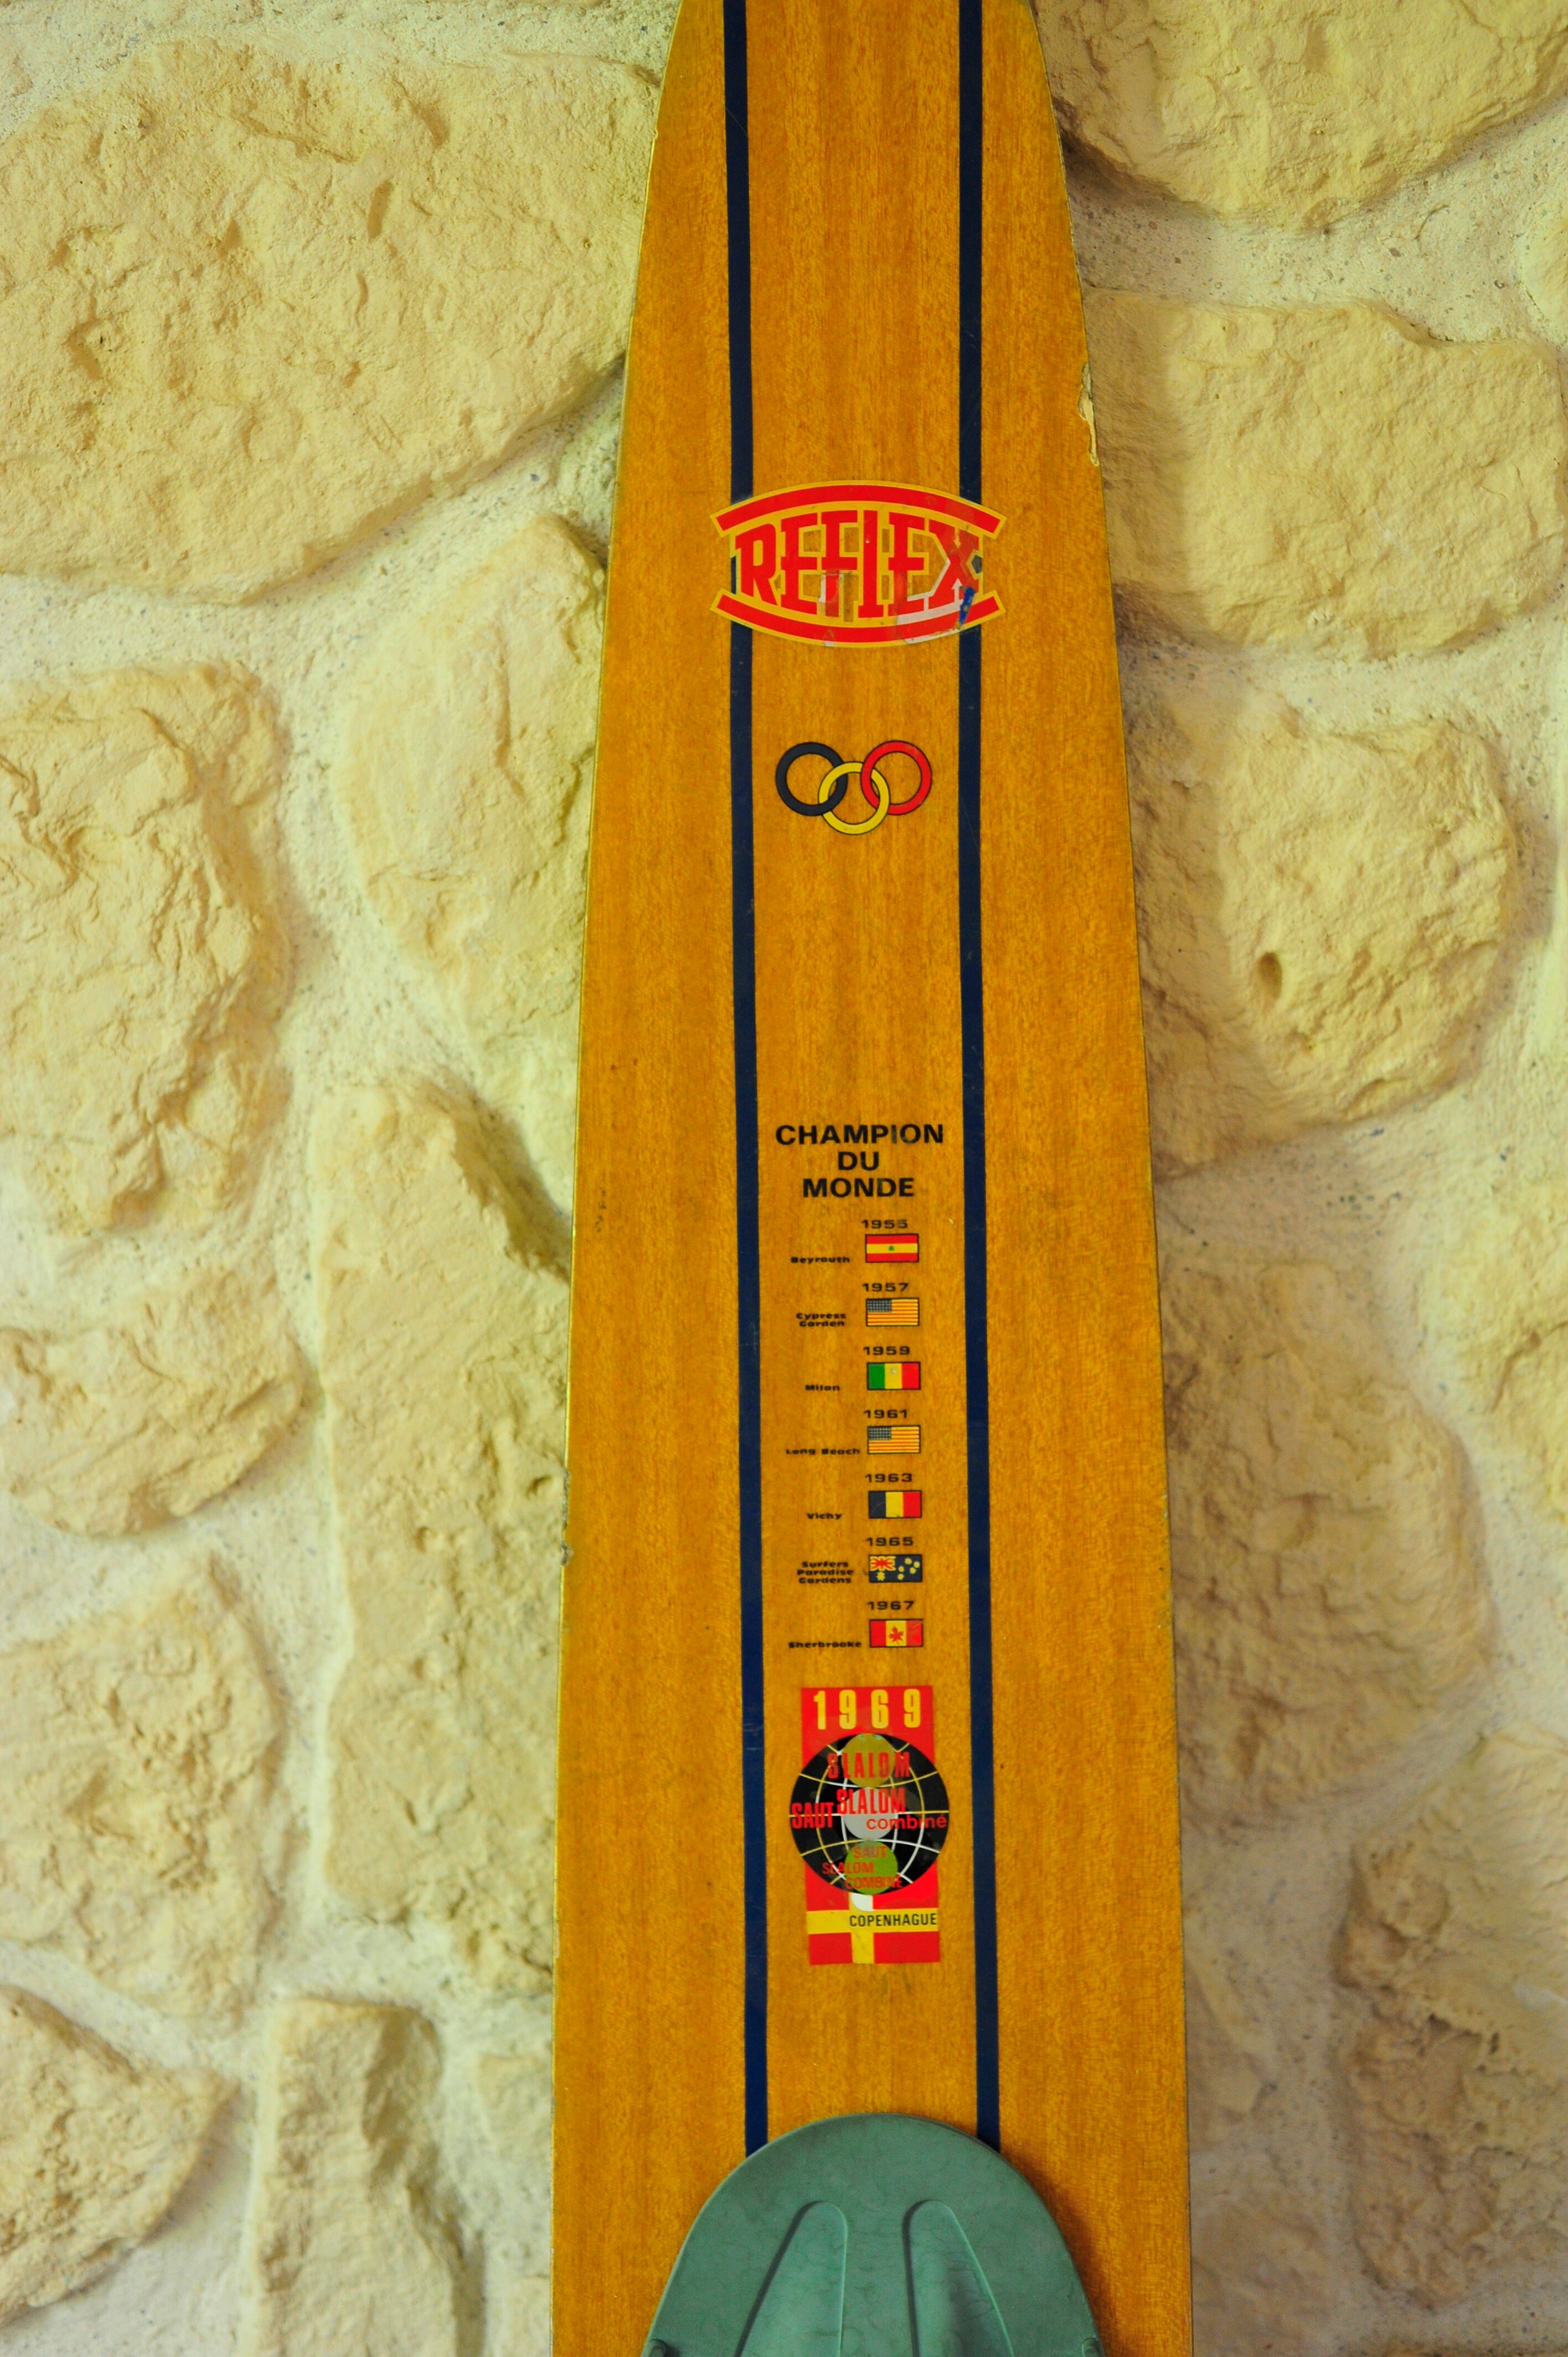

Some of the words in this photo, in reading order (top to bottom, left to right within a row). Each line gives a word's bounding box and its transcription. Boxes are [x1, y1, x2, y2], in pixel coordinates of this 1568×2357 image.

[735, 510, 980, 617] REFLEX
[776, 1124, 943, 1145] CHAMPION
[838, 1151, 879, 1171] DU
[803, 1178, 915, 1198] MONDE
[862, 1219, 908, 1229] 1955
[791, 1256, 850, 1264] Beyrouth
[863, 1283, 909, 1292] 1957
[863, 1346, 910, 1356] 1959
[864, 1409, 908, 1419] 1961
[865, 1473, 913, 1483] 1963
[866, 1537, 914, 1547] 1965
[867, 1601, 914, 1611] 1967
[813, 1689, 921, 1730] 1969
[827, 1751, 910, 1779] SLALOM
[837, 1788, 906, 1815] SLALOM
[791, 1802, 834, 1829] SAUT
[849, 1913, 937, 1927] COPENHAGUE
